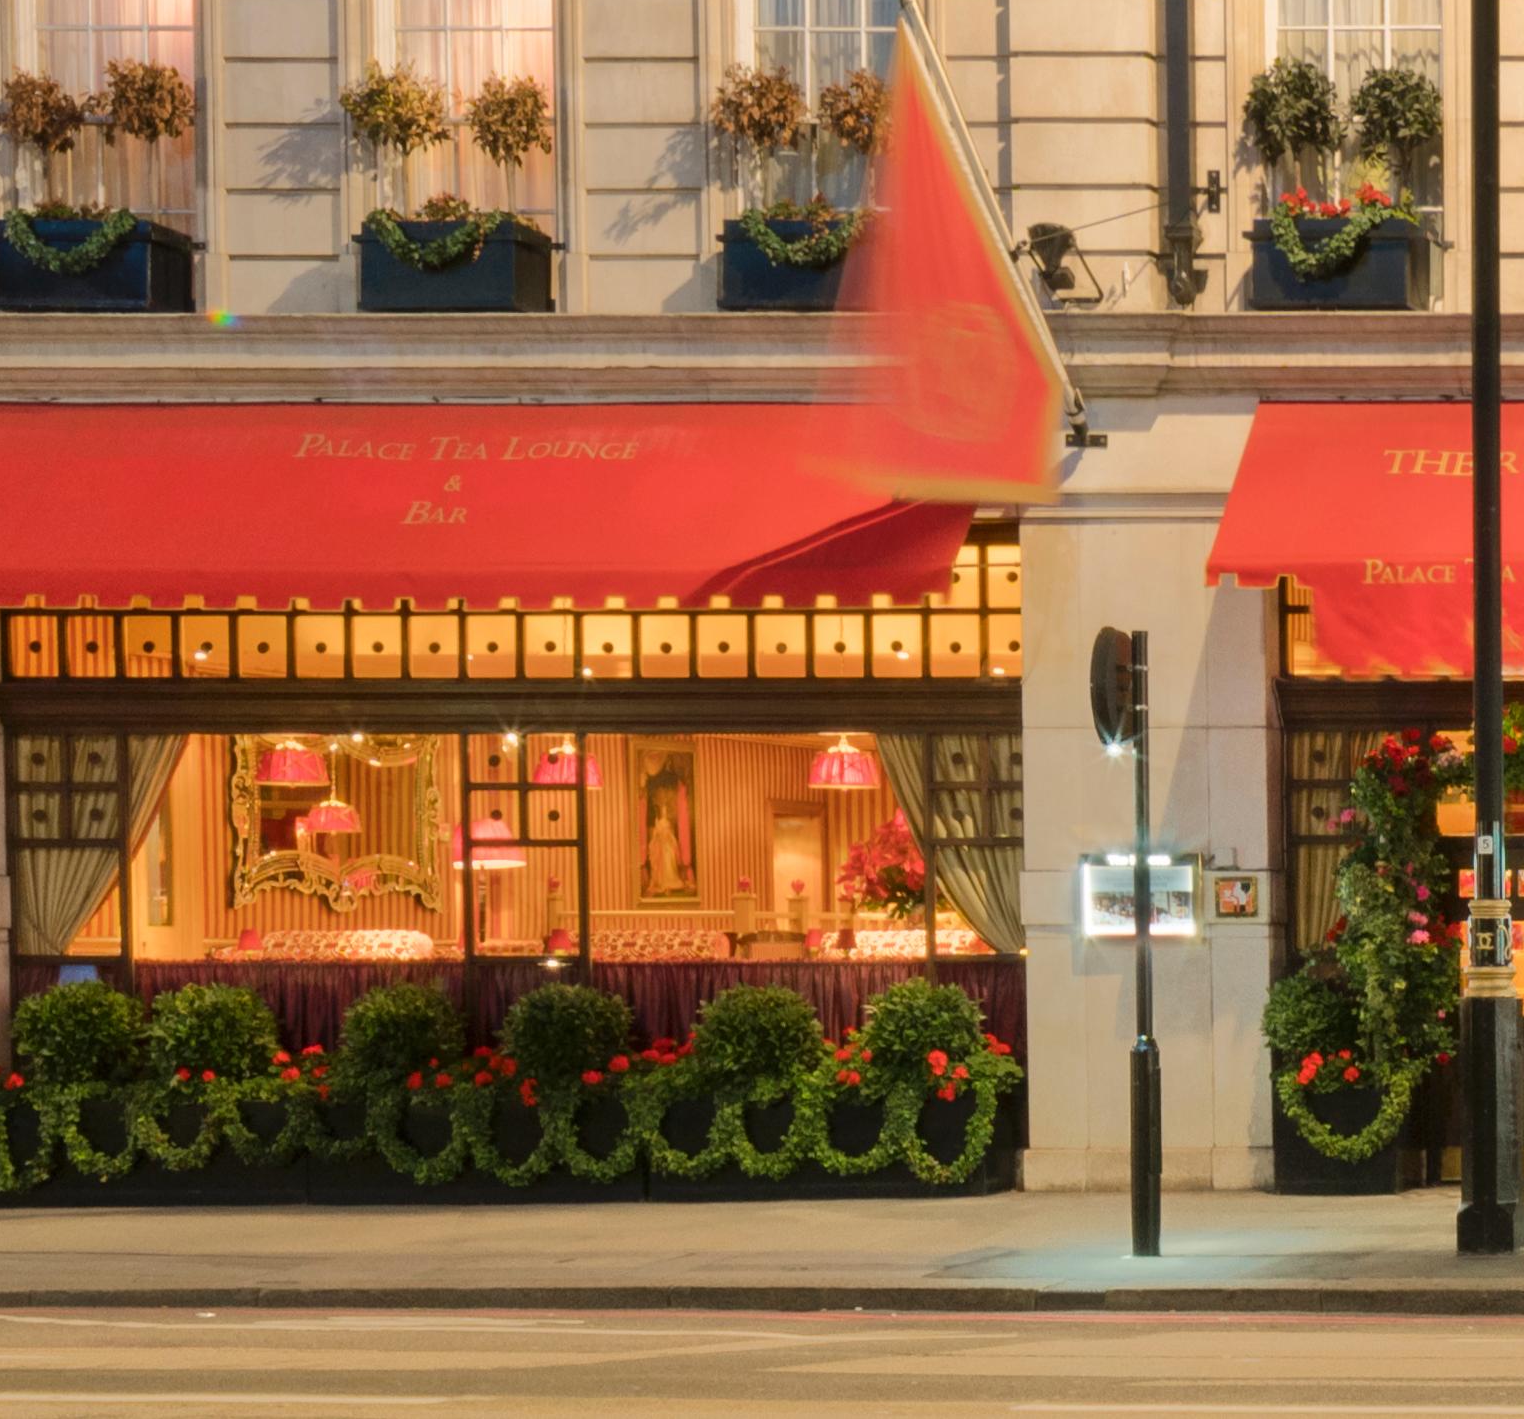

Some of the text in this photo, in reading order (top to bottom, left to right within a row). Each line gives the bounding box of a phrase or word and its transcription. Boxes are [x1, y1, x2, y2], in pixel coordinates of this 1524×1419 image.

[292, 433, 640, 461] PALACE TEA LOUNGE
[1383, 449, 1474, 476] THE
[443, 474, 462, 492] &
[399, 500, 468, 525] BAR
[1363, 558, 1457, 584] PALACE
[1482, 838, 1490, 849] 5
